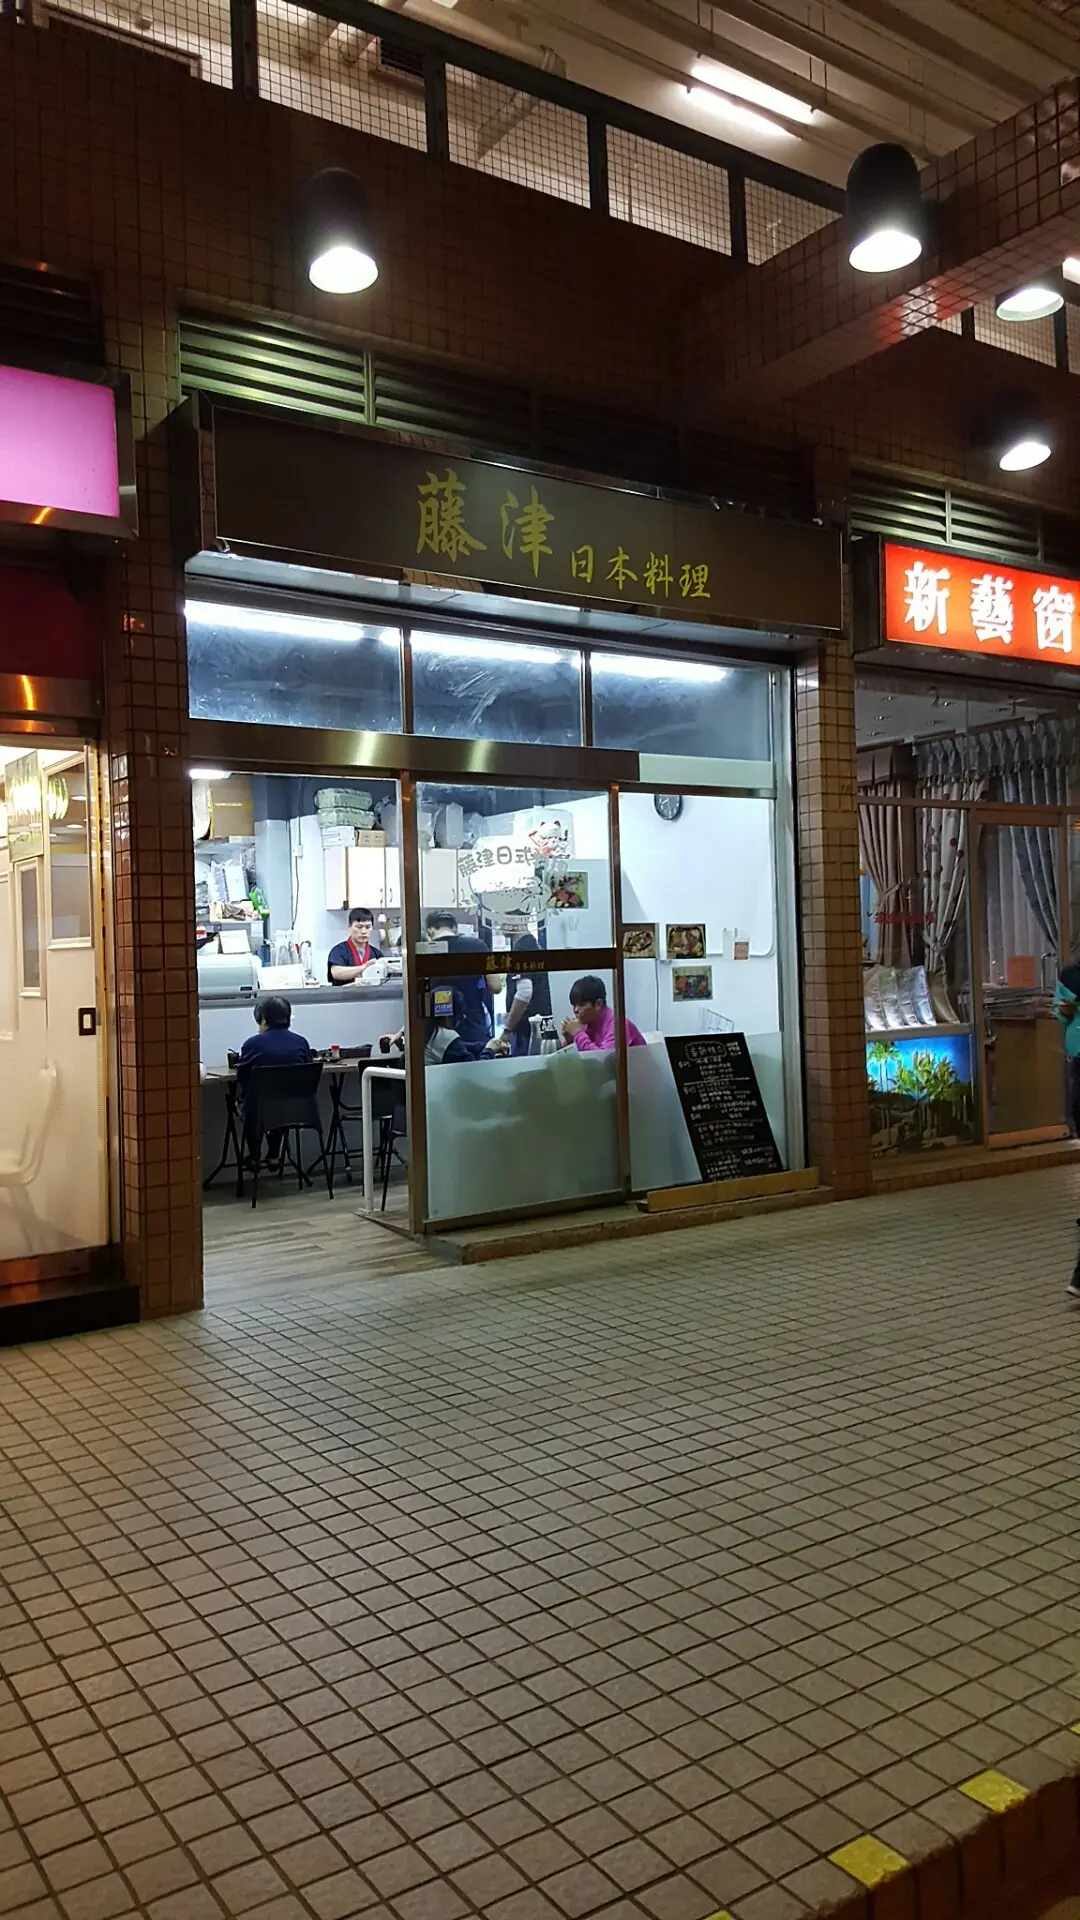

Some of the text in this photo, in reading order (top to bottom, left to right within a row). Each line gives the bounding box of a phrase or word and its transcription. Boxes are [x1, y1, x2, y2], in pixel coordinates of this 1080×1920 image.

[416, 468, 711, 598] 藤津 日本料理
[904, 561, 1076, 654] 新藝窗
